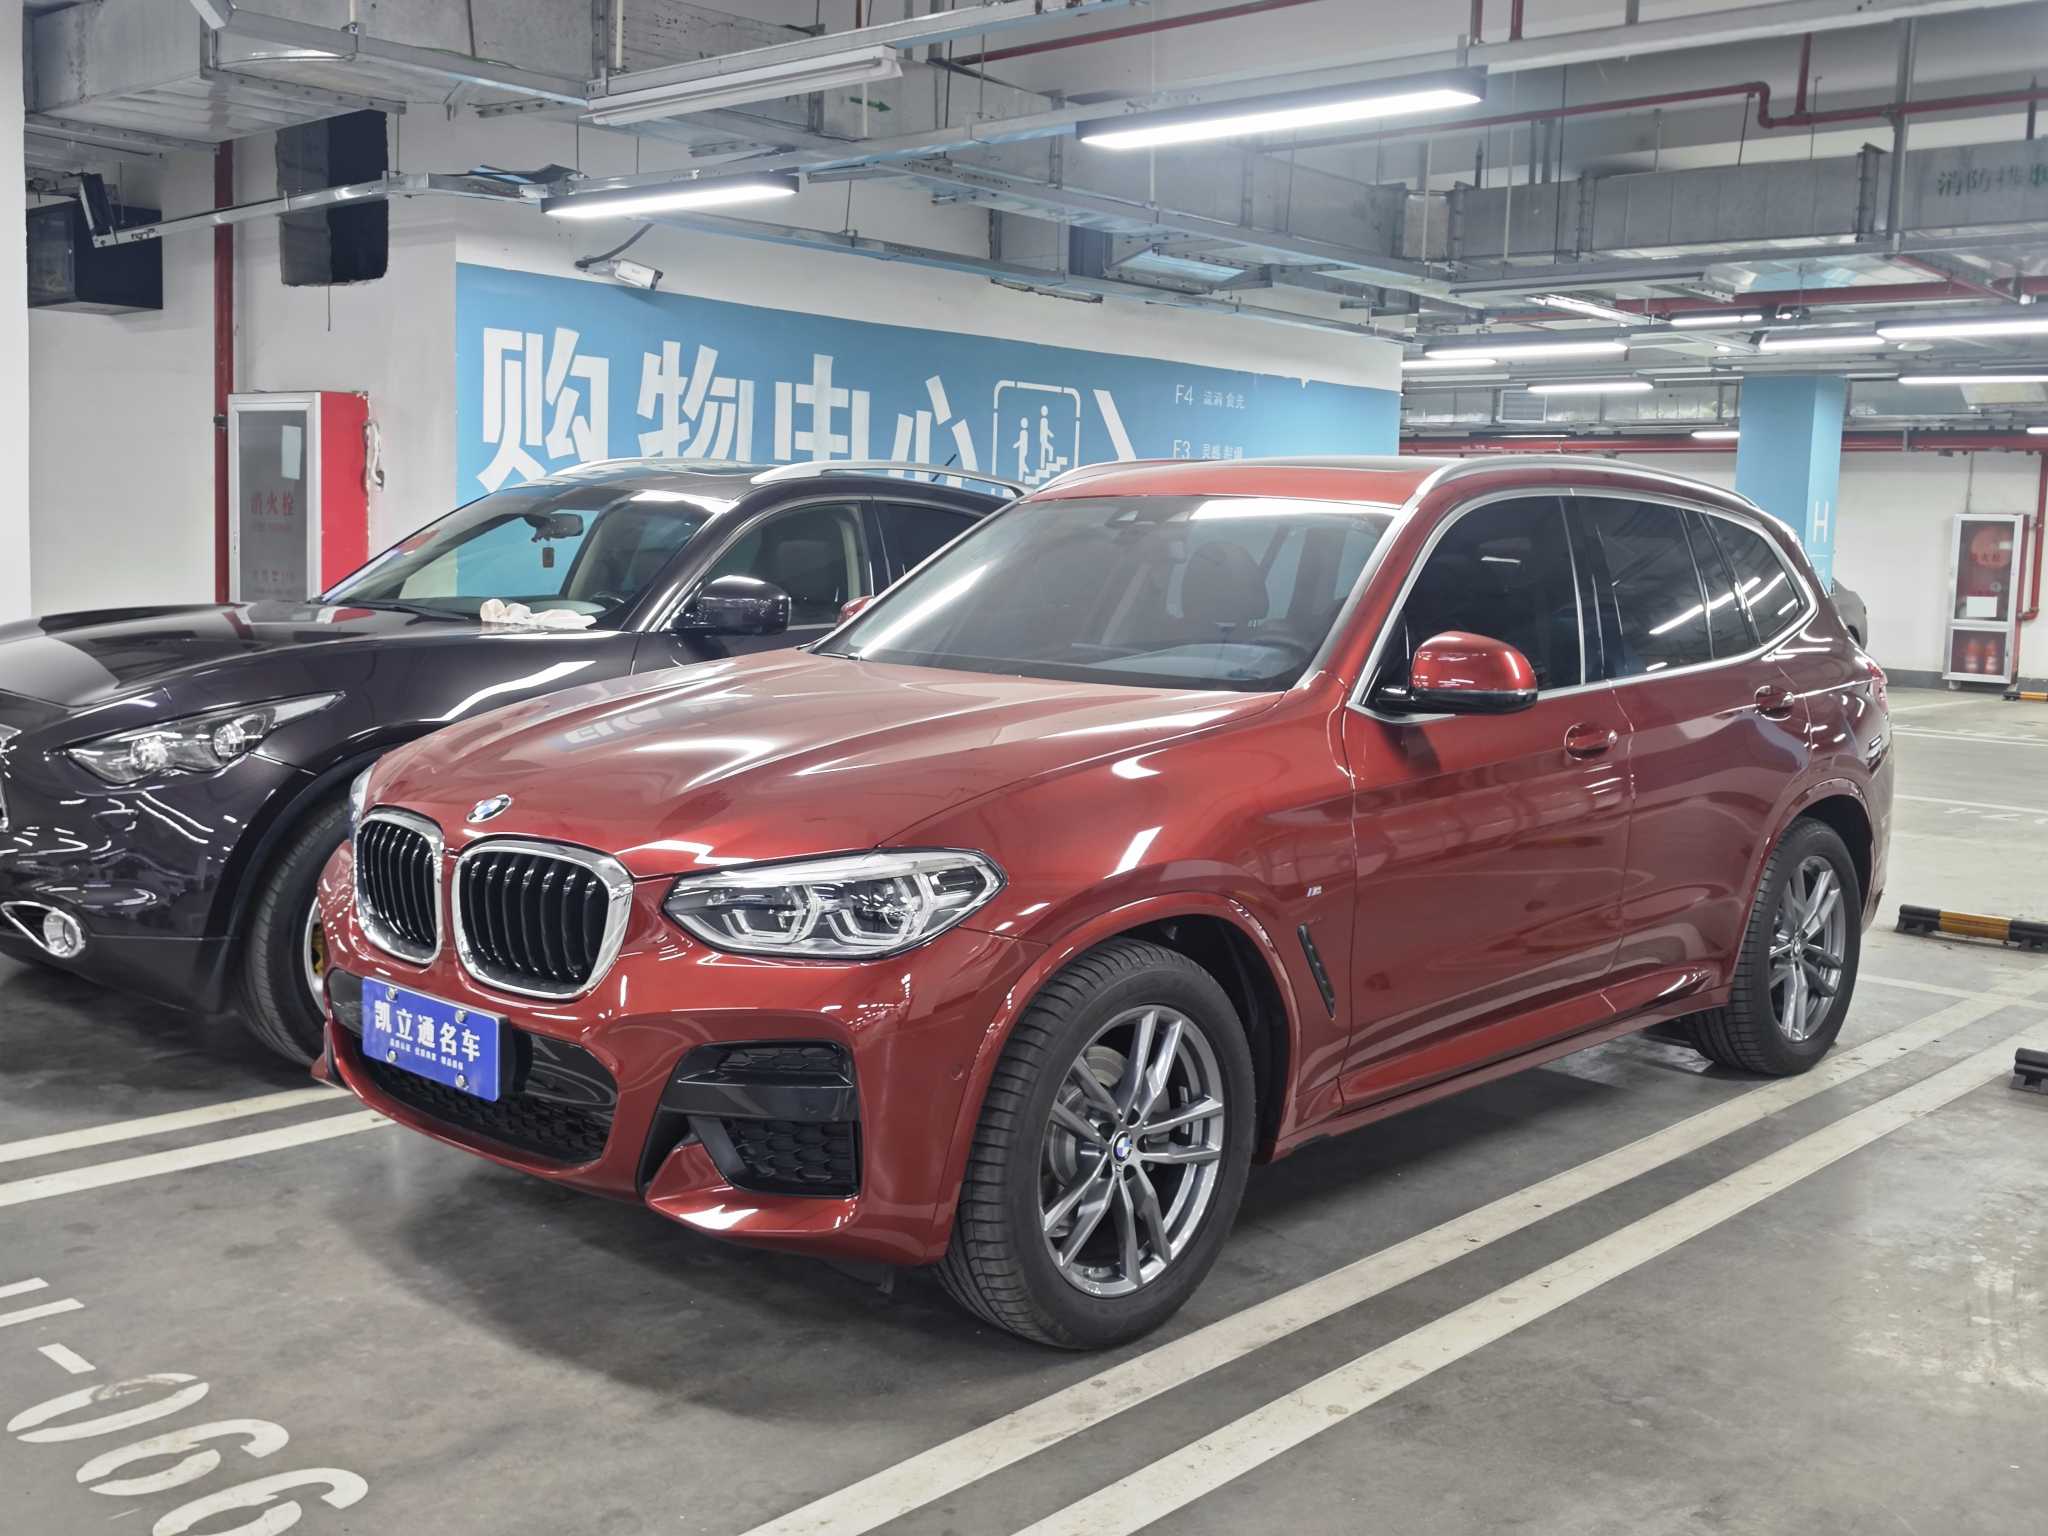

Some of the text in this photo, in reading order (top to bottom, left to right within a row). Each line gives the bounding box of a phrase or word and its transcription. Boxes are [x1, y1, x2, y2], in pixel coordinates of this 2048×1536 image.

[476, 327, 980, 492] 购物中心
[1175, 384, 1194, 406] F4
[1173, 439, 1192, 460] F3
[1813, 500, 1830, 543] H
[374, 999, 481, 1062] 凯立通名车
